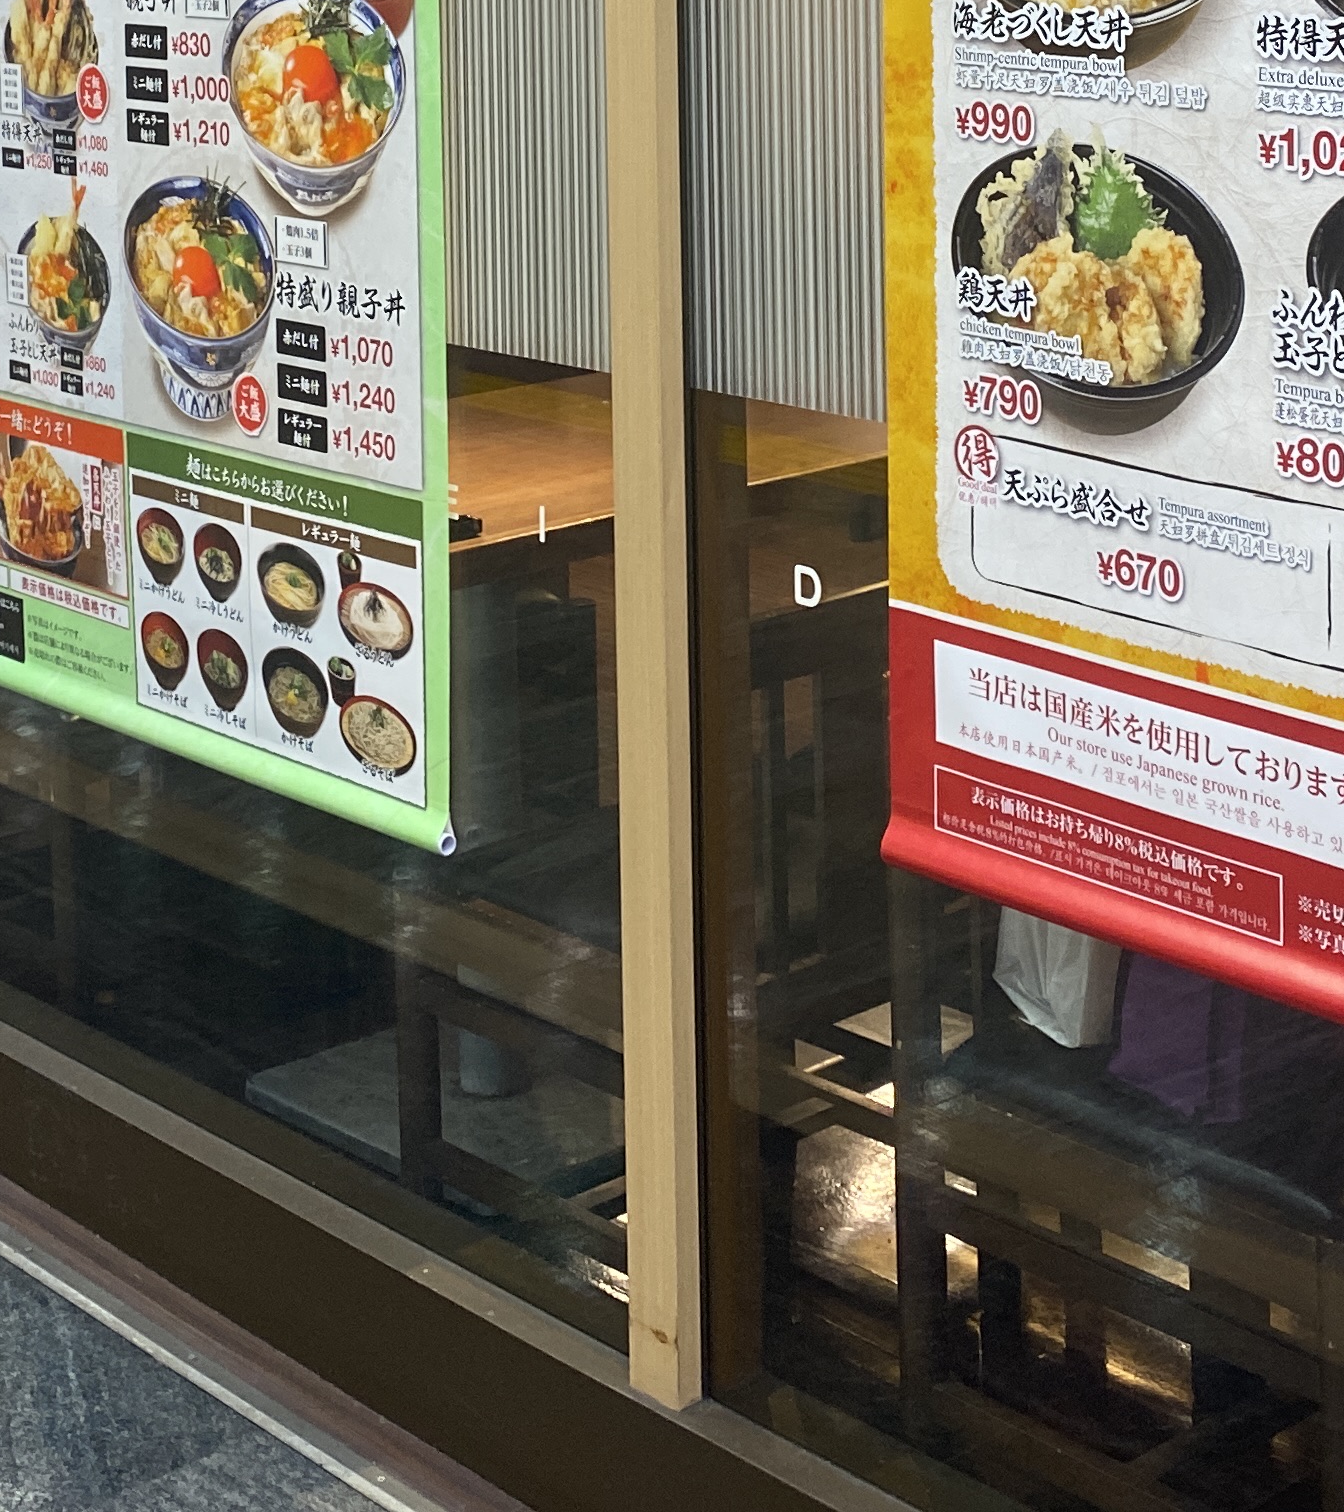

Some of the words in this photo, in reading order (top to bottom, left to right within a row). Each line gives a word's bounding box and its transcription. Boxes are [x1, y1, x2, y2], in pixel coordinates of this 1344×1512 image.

[954, 0, 1129, 48] 海老づくし天丼
[131, 32, 162, 49] 赤だし付
[172, 32, 210, 57] ¥830
[132, 75, 163, 93] ミニ麺付
[172, 75, 230, 104] ¥1,000
[173, 118, 230, 147] ¥1,210
[956, 101, 1032, 141] ¥990
[79, 163, 108, 177] ¥1,460
[276, 271, 406, 326] 特盛り親子丼
[958, 271, 1034, 318] 鶏天丼
[331, 336, 393, 368] ¥1,070
[332, 380, 395, 414] ¥1,240
[964, 375, 1038, 421] ¥790
[333, 427, 396, 461] ¥1,450
[175, 489, 200, 510] ミニ麺
[1002, 469, 1149, 527] 天ぷら盛合せ
[300, 522, 361, 552] レギュラー麺
[1096, 548, 1180, 598] ¥670
